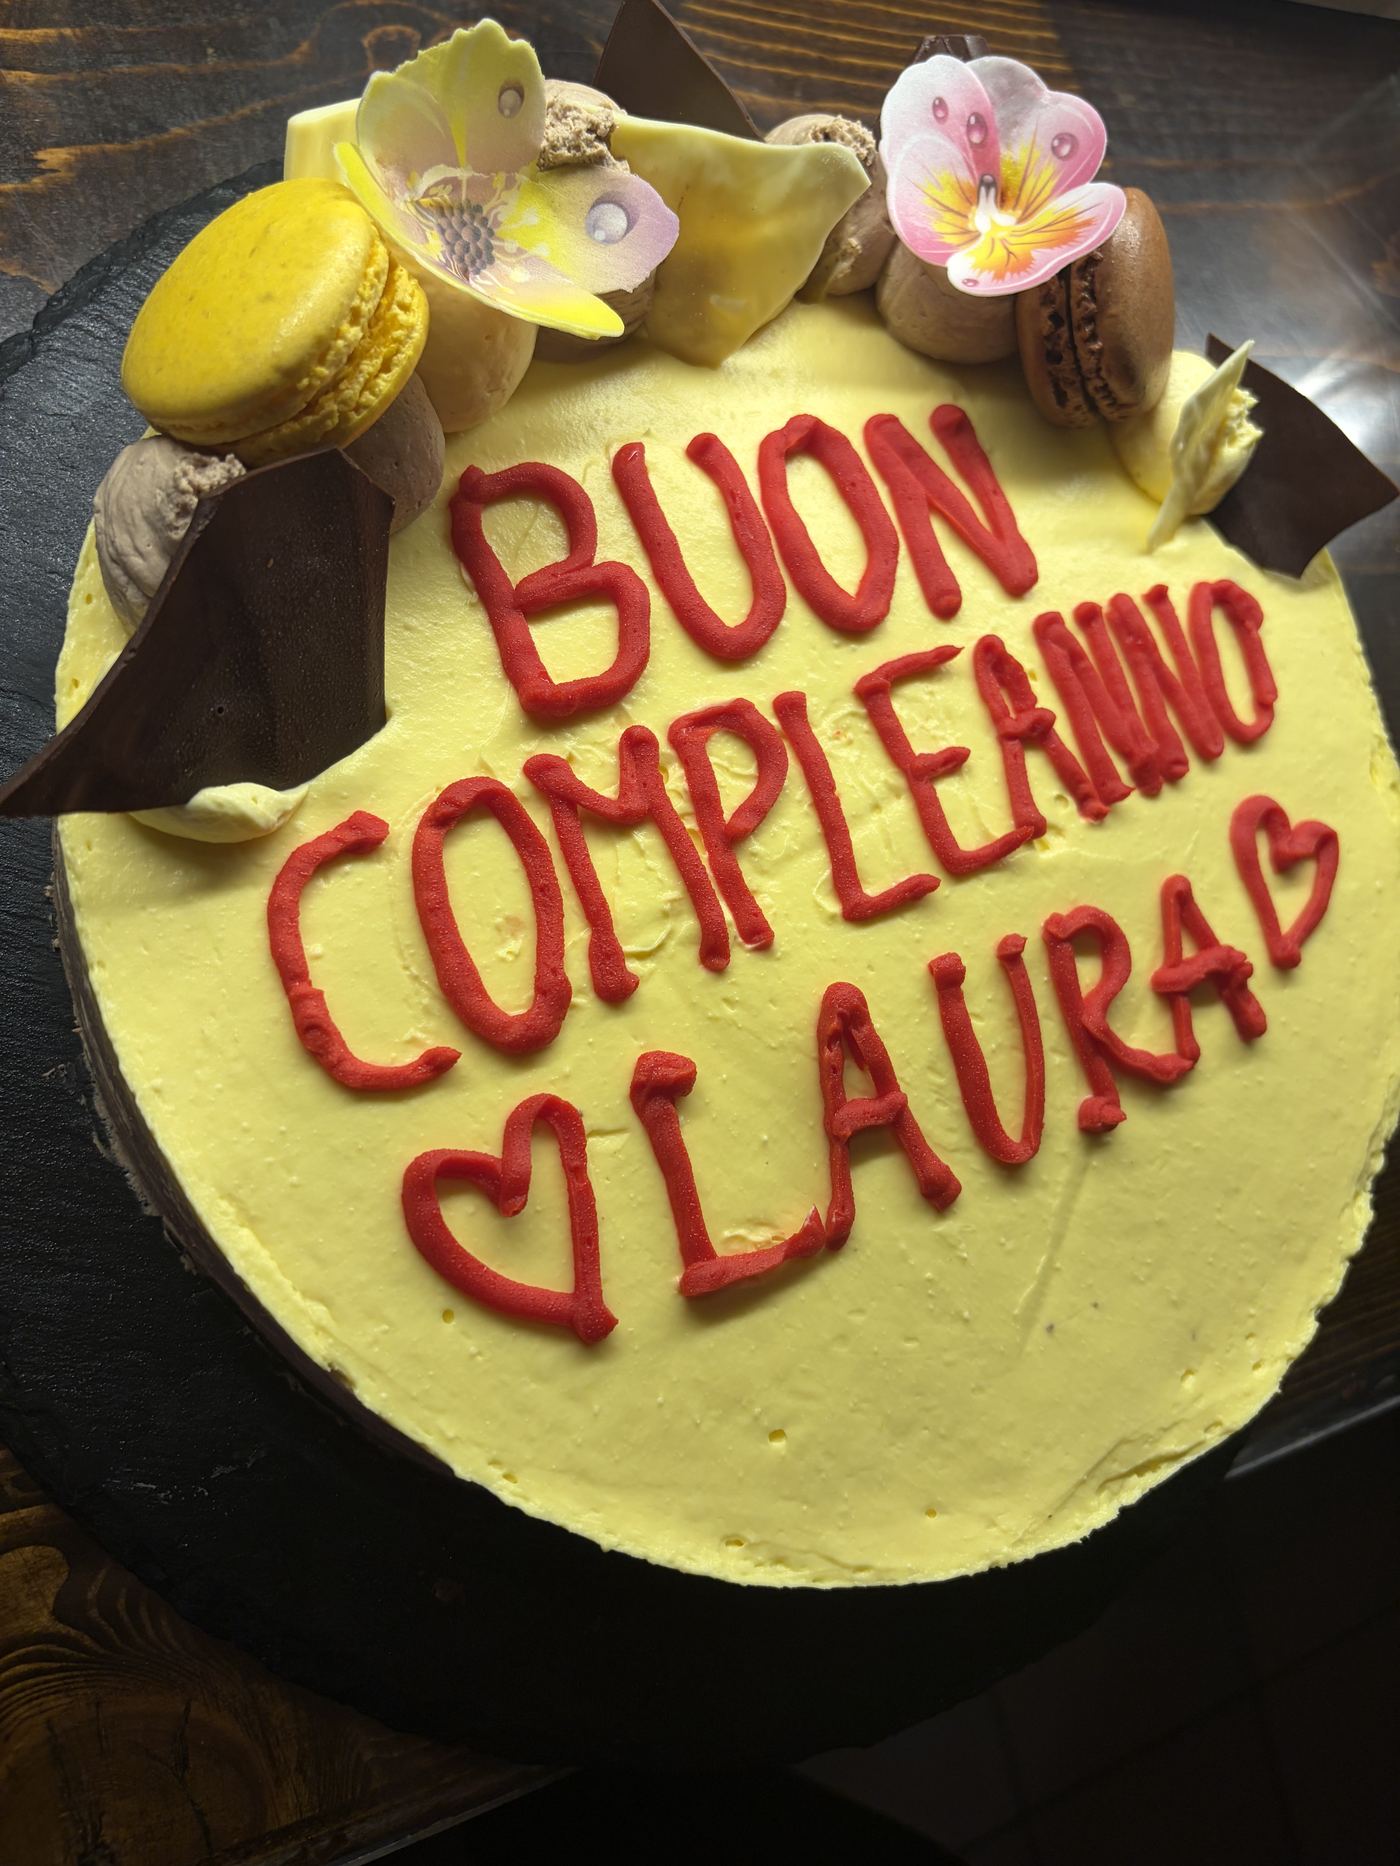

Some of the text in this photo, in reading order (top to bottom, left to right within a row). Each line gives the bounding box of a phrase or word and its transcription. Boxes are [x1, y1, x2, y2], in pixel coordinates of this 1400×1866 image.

[450, 403, 1040, 724] BUON
[265, 578, 1279, 1092] COMPLEANNO
[628, 873, 1268, 1298] LAURA
